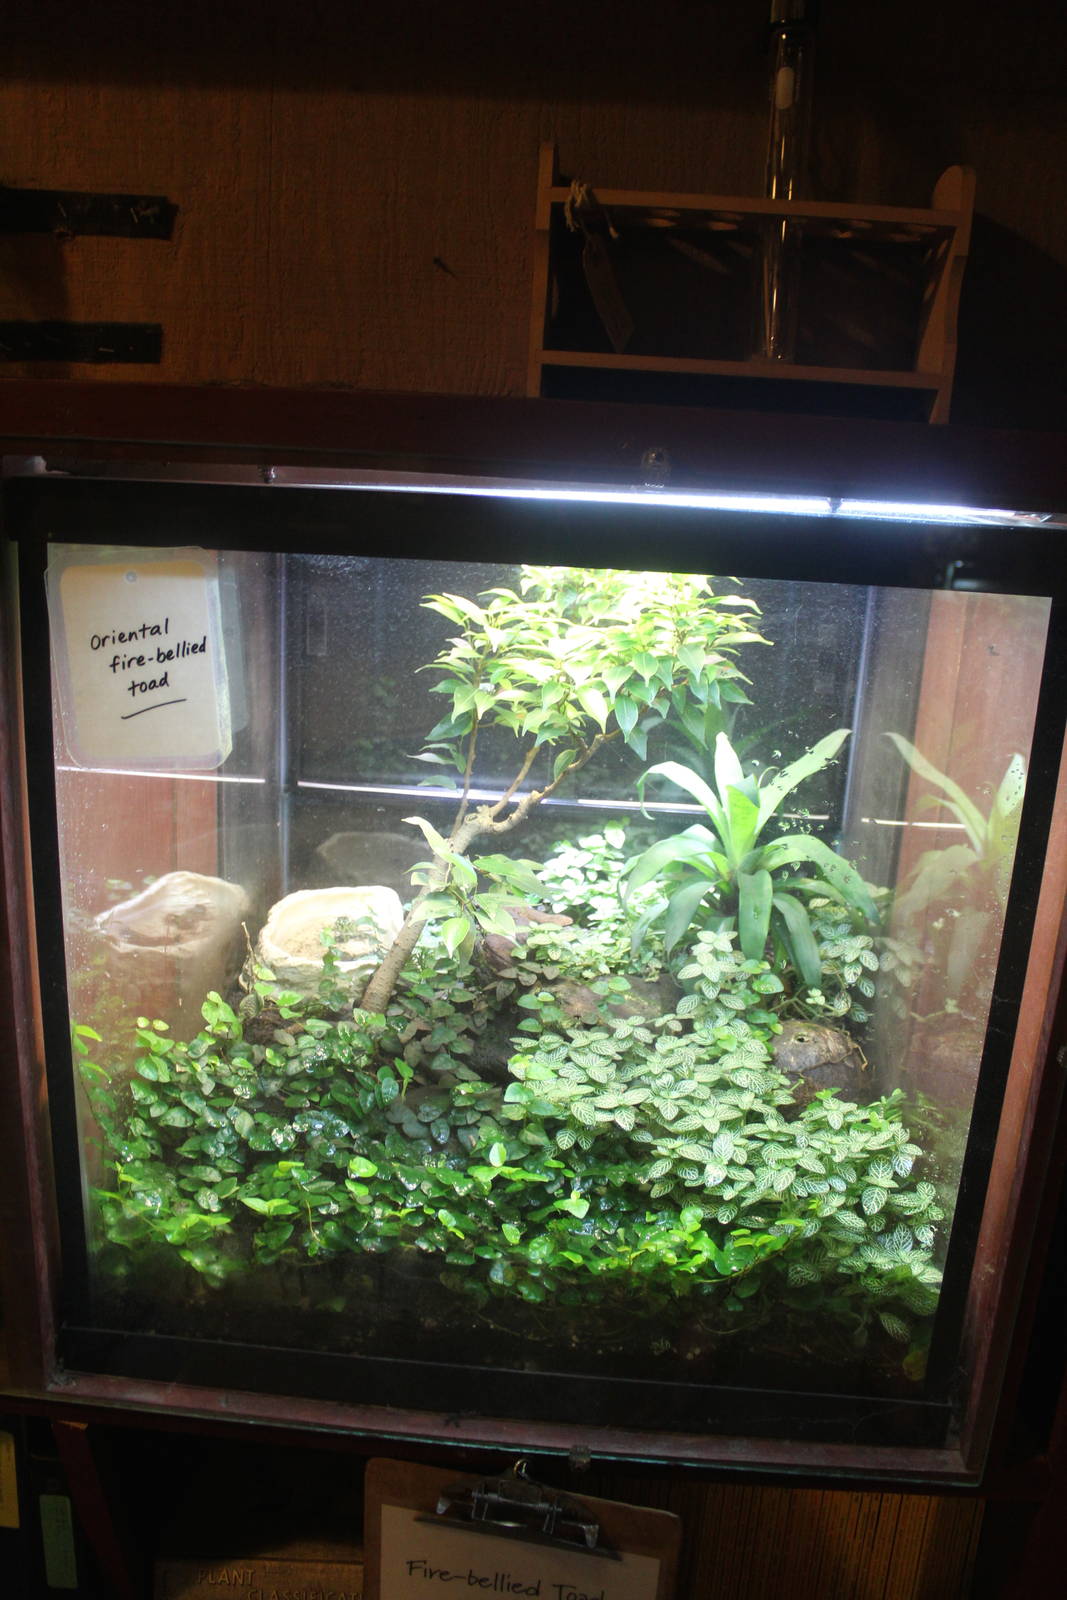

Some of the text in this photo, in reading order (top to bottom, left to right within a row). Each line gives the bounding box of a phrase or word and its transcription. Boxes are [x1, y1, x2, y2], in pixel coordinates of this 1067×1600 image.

[90, 617, 169, 650] Oriental
[108, 635, 207, 673] fire-bellied
[127, 671, 170, 696] toad
[198, 1567, 256, 1586] PLANT
[406, 1559, 541, 1596] Fire-bellied
